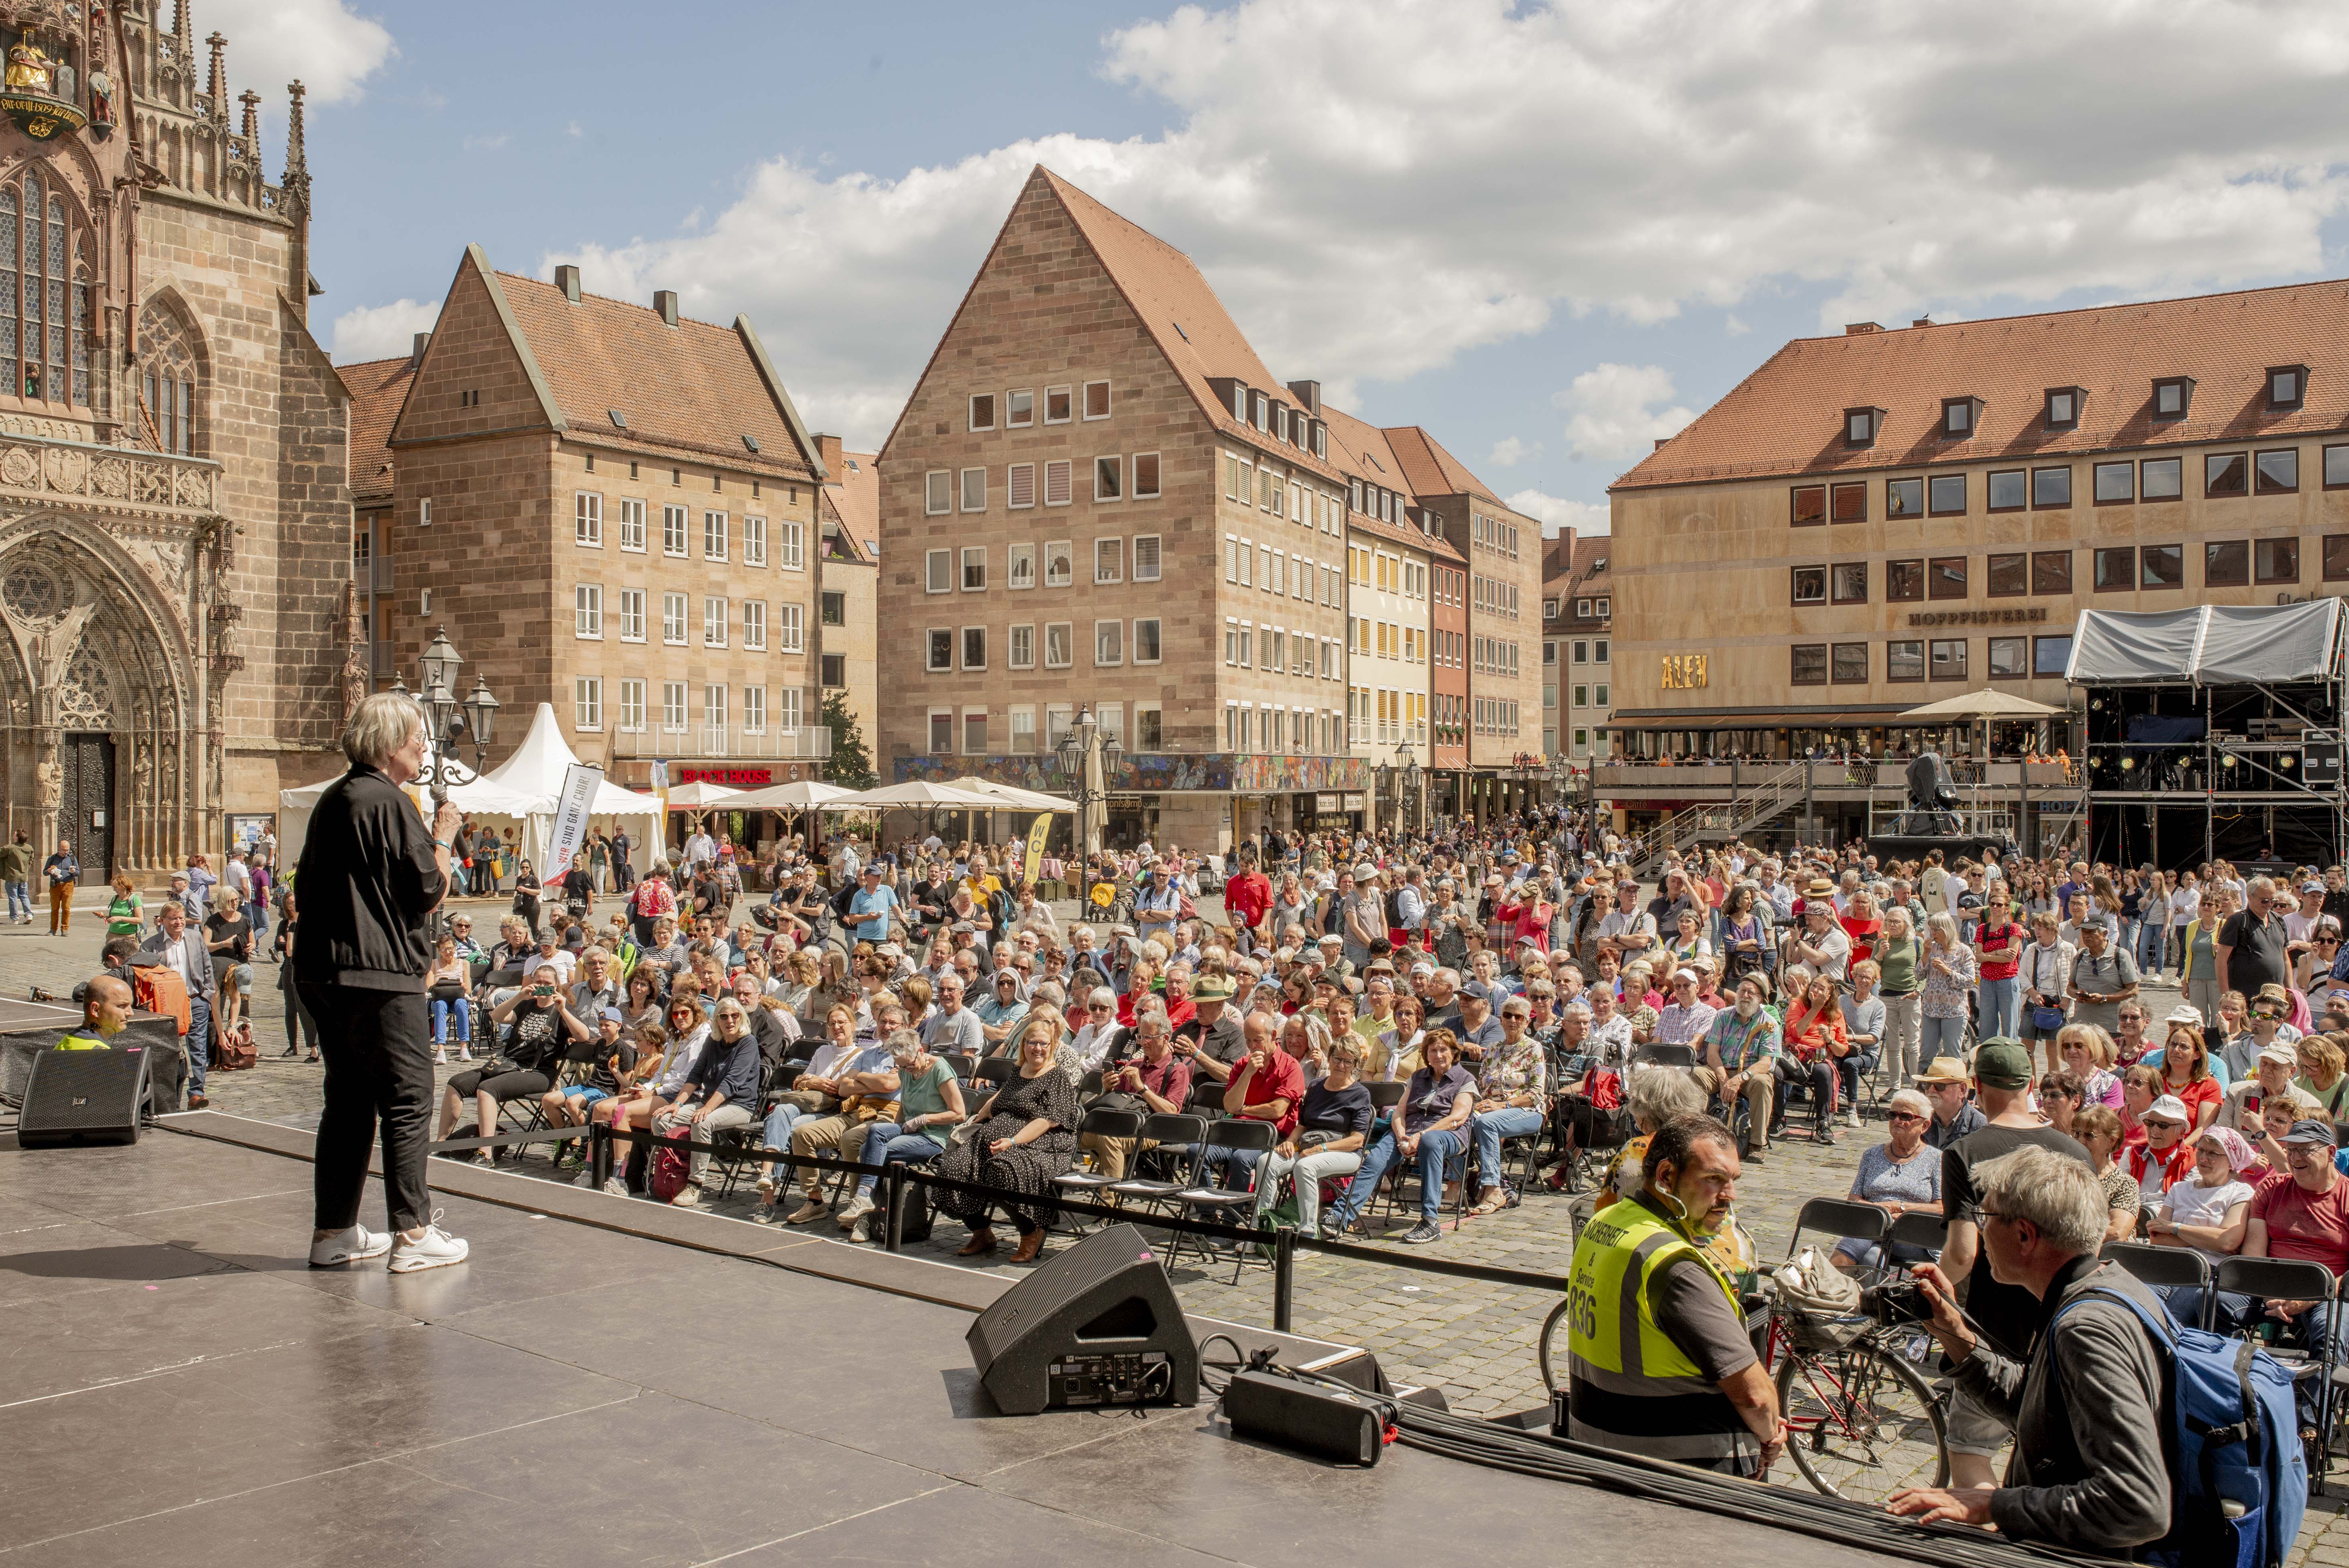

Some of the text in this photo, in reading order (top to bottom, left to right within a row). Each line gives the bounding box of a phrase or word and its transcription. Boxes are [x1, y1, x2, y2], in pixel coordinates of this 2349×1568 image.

[35, 102, 52, 113] 1509
[1908, 609, 2046, 625] HOFPFISTEREI
[1661, 655, 1707, 689] ALEX
[683, 770, 771, 784] BLOCK HOUSE
[558, 775, 591, 863] WIR SIND GANZ CHOR!
[1031, 824, 1045, 853] WC
[1583, 1219, 1630, 1248] SICHERHEIT
[1589, 1252, 1595, 1267] &
[1576, 1268, 1594, 1289] Service
[1569, 1285, 1596, 1340] 836
